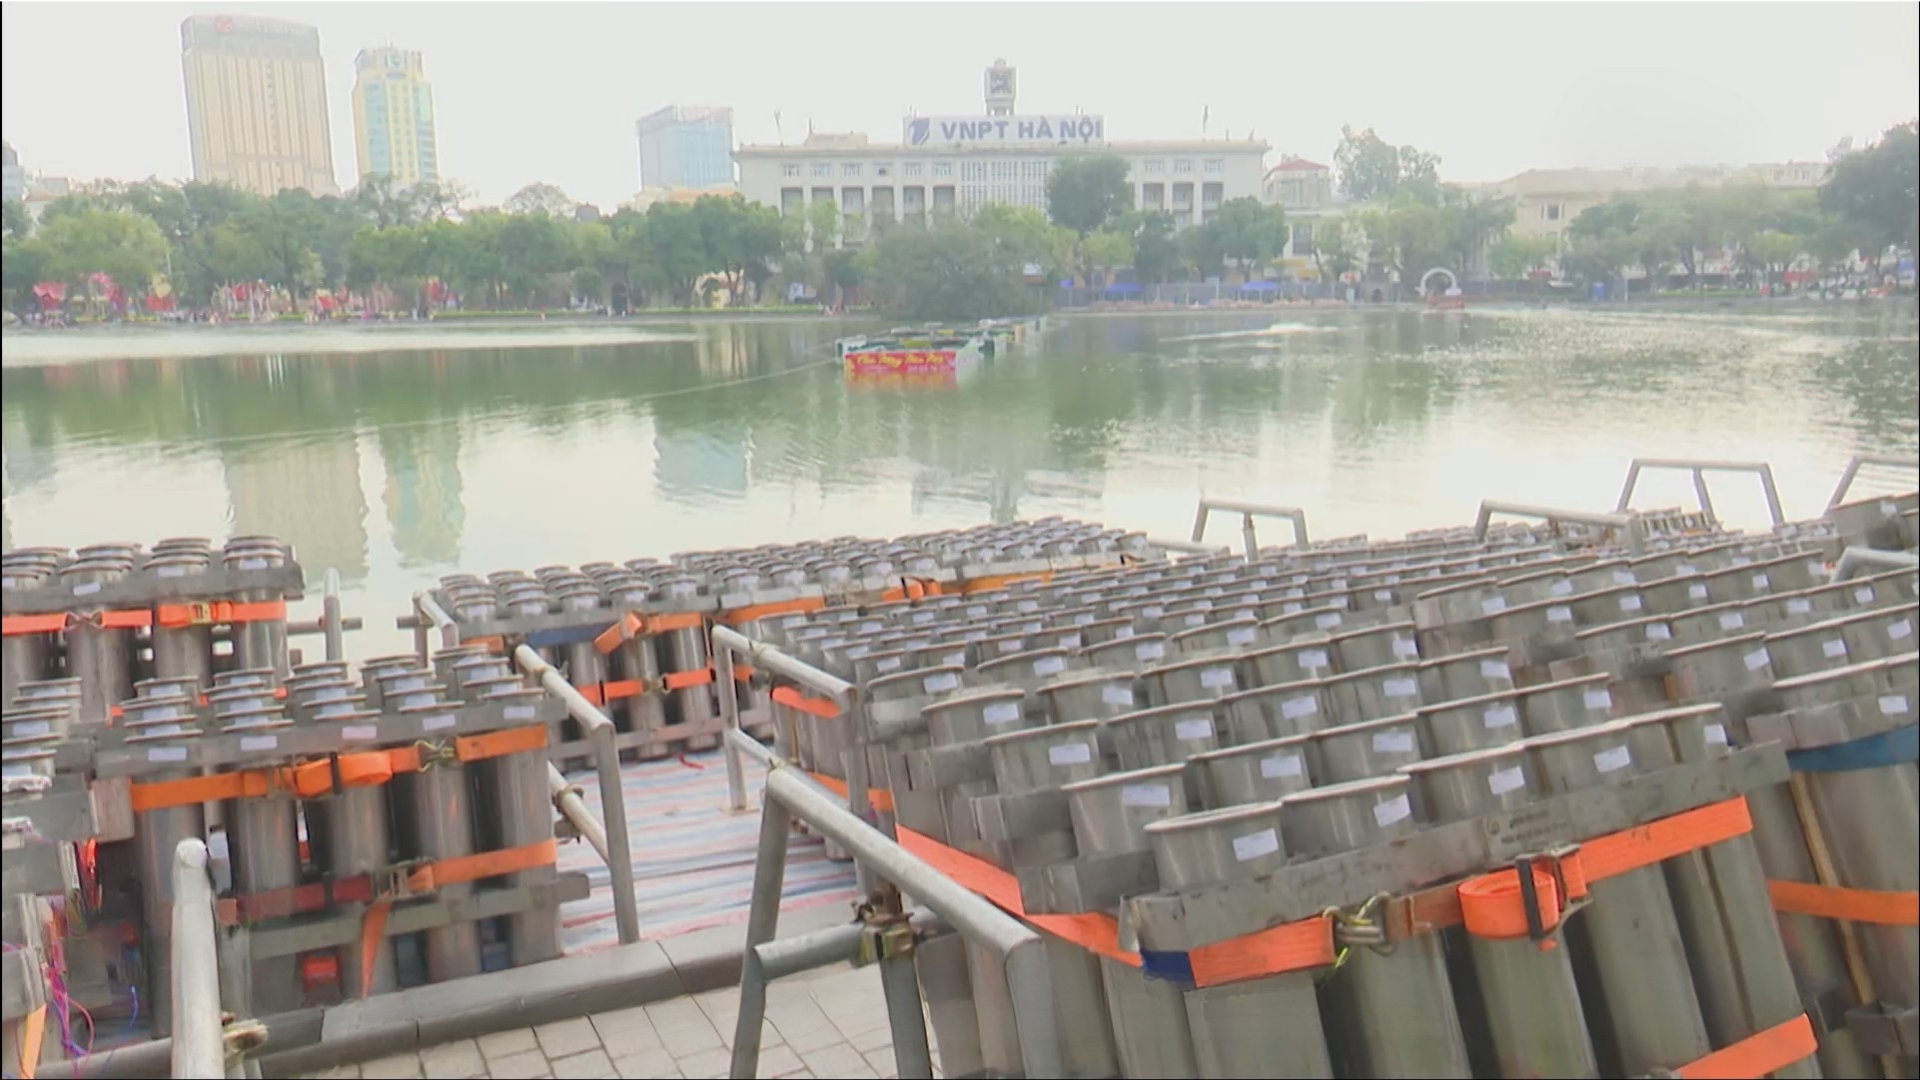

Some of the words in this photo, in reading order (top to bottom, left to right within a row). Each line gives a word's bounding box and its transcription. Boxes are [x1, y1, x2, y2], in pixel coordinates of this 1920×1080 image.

[941, 120, 1009, 140] VNPT
[1018, 115, 1053, 138] HÀ
[1060, 115, 1101, 142] NỘI
